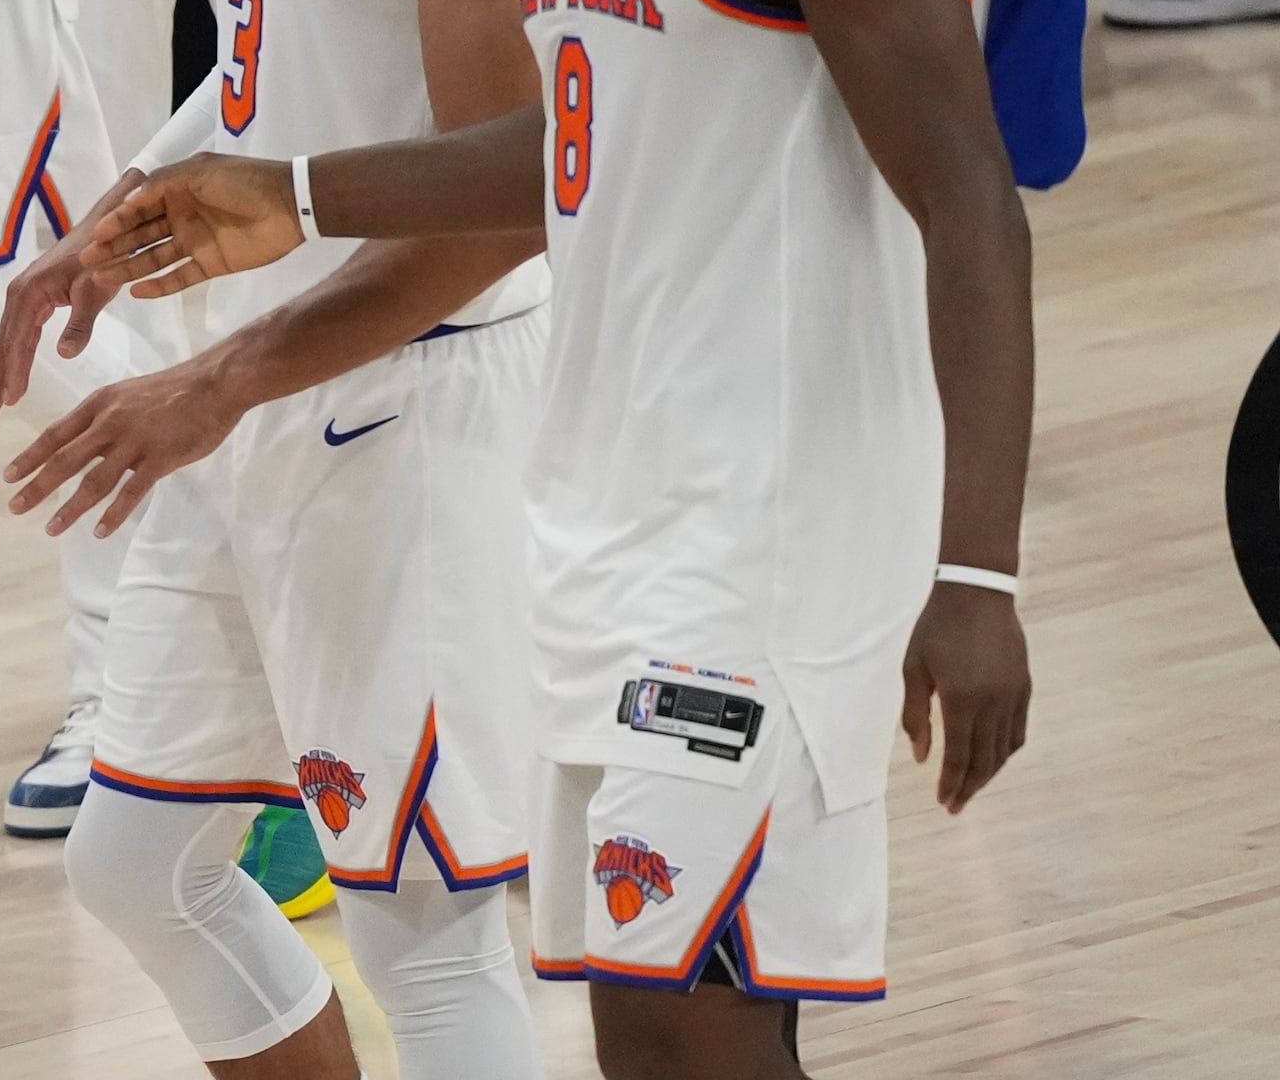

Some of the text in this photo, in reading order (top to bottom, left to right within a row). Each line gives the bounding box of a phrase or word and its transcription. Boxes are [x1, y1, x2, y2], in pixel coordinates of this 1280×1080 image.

[554, 36, 593, 217] 8
[299, 754, 367, 801] KNICKS
[593, 839, 674, 897] KNICKS
